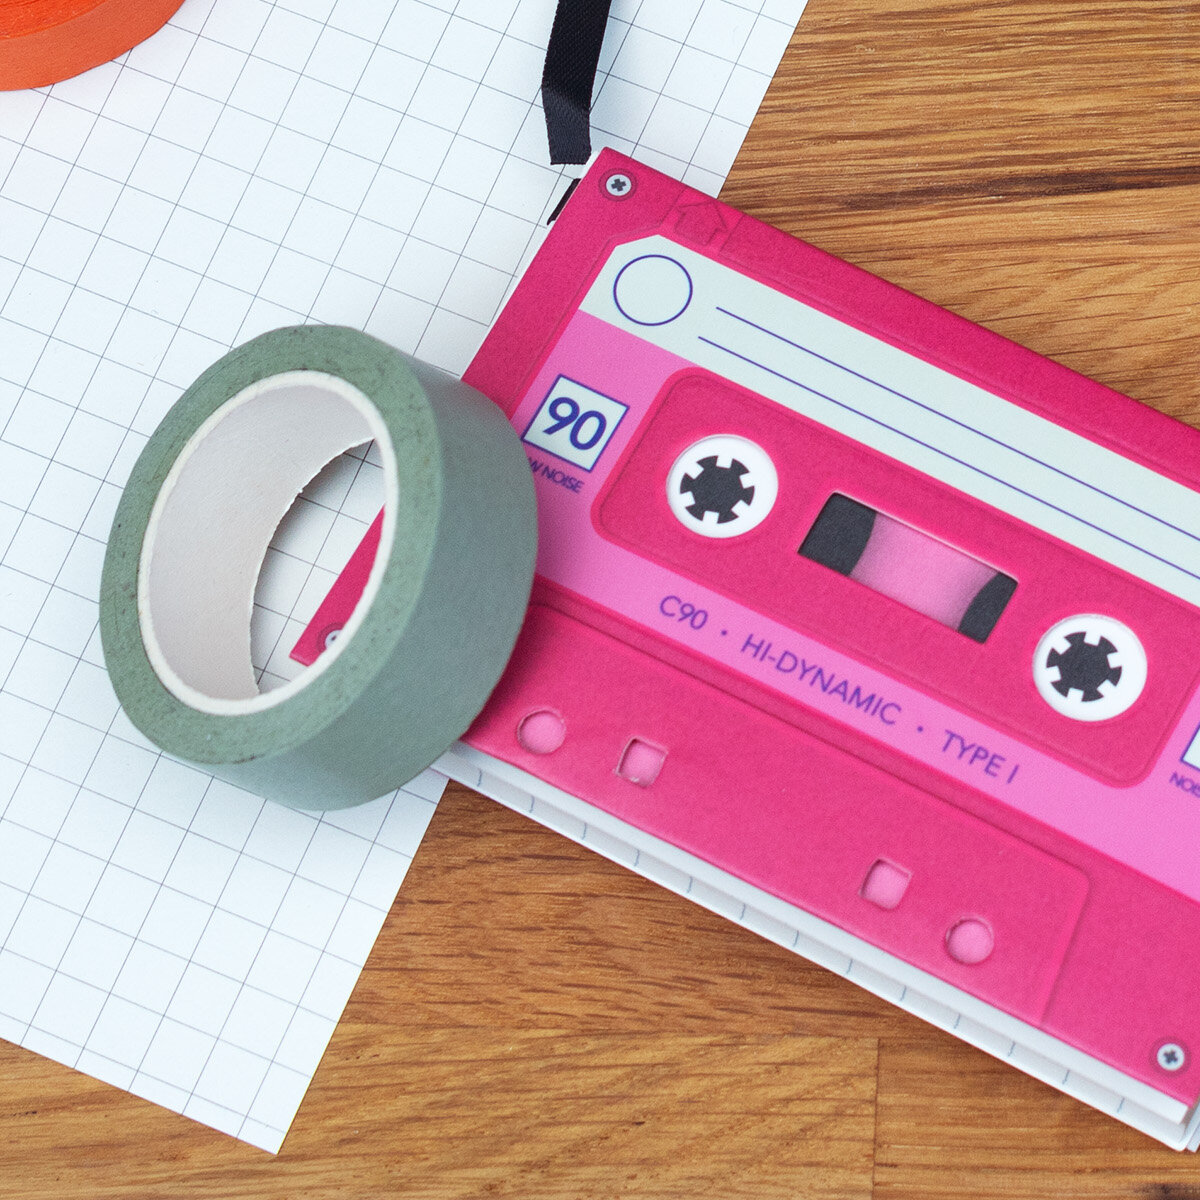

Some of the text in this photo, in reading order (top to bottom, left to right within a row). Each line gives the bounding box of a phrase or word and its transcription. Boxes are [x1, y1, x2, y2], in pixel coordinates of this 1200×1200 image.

[542, 396, 608, 451] 90
[541, 465, 585, 493] NOISE
[659, 595, 709, 631] C90
[740, 633, 902, 726] HI-DYNAMIC
[941, 729, 1005, 777] TYPE
